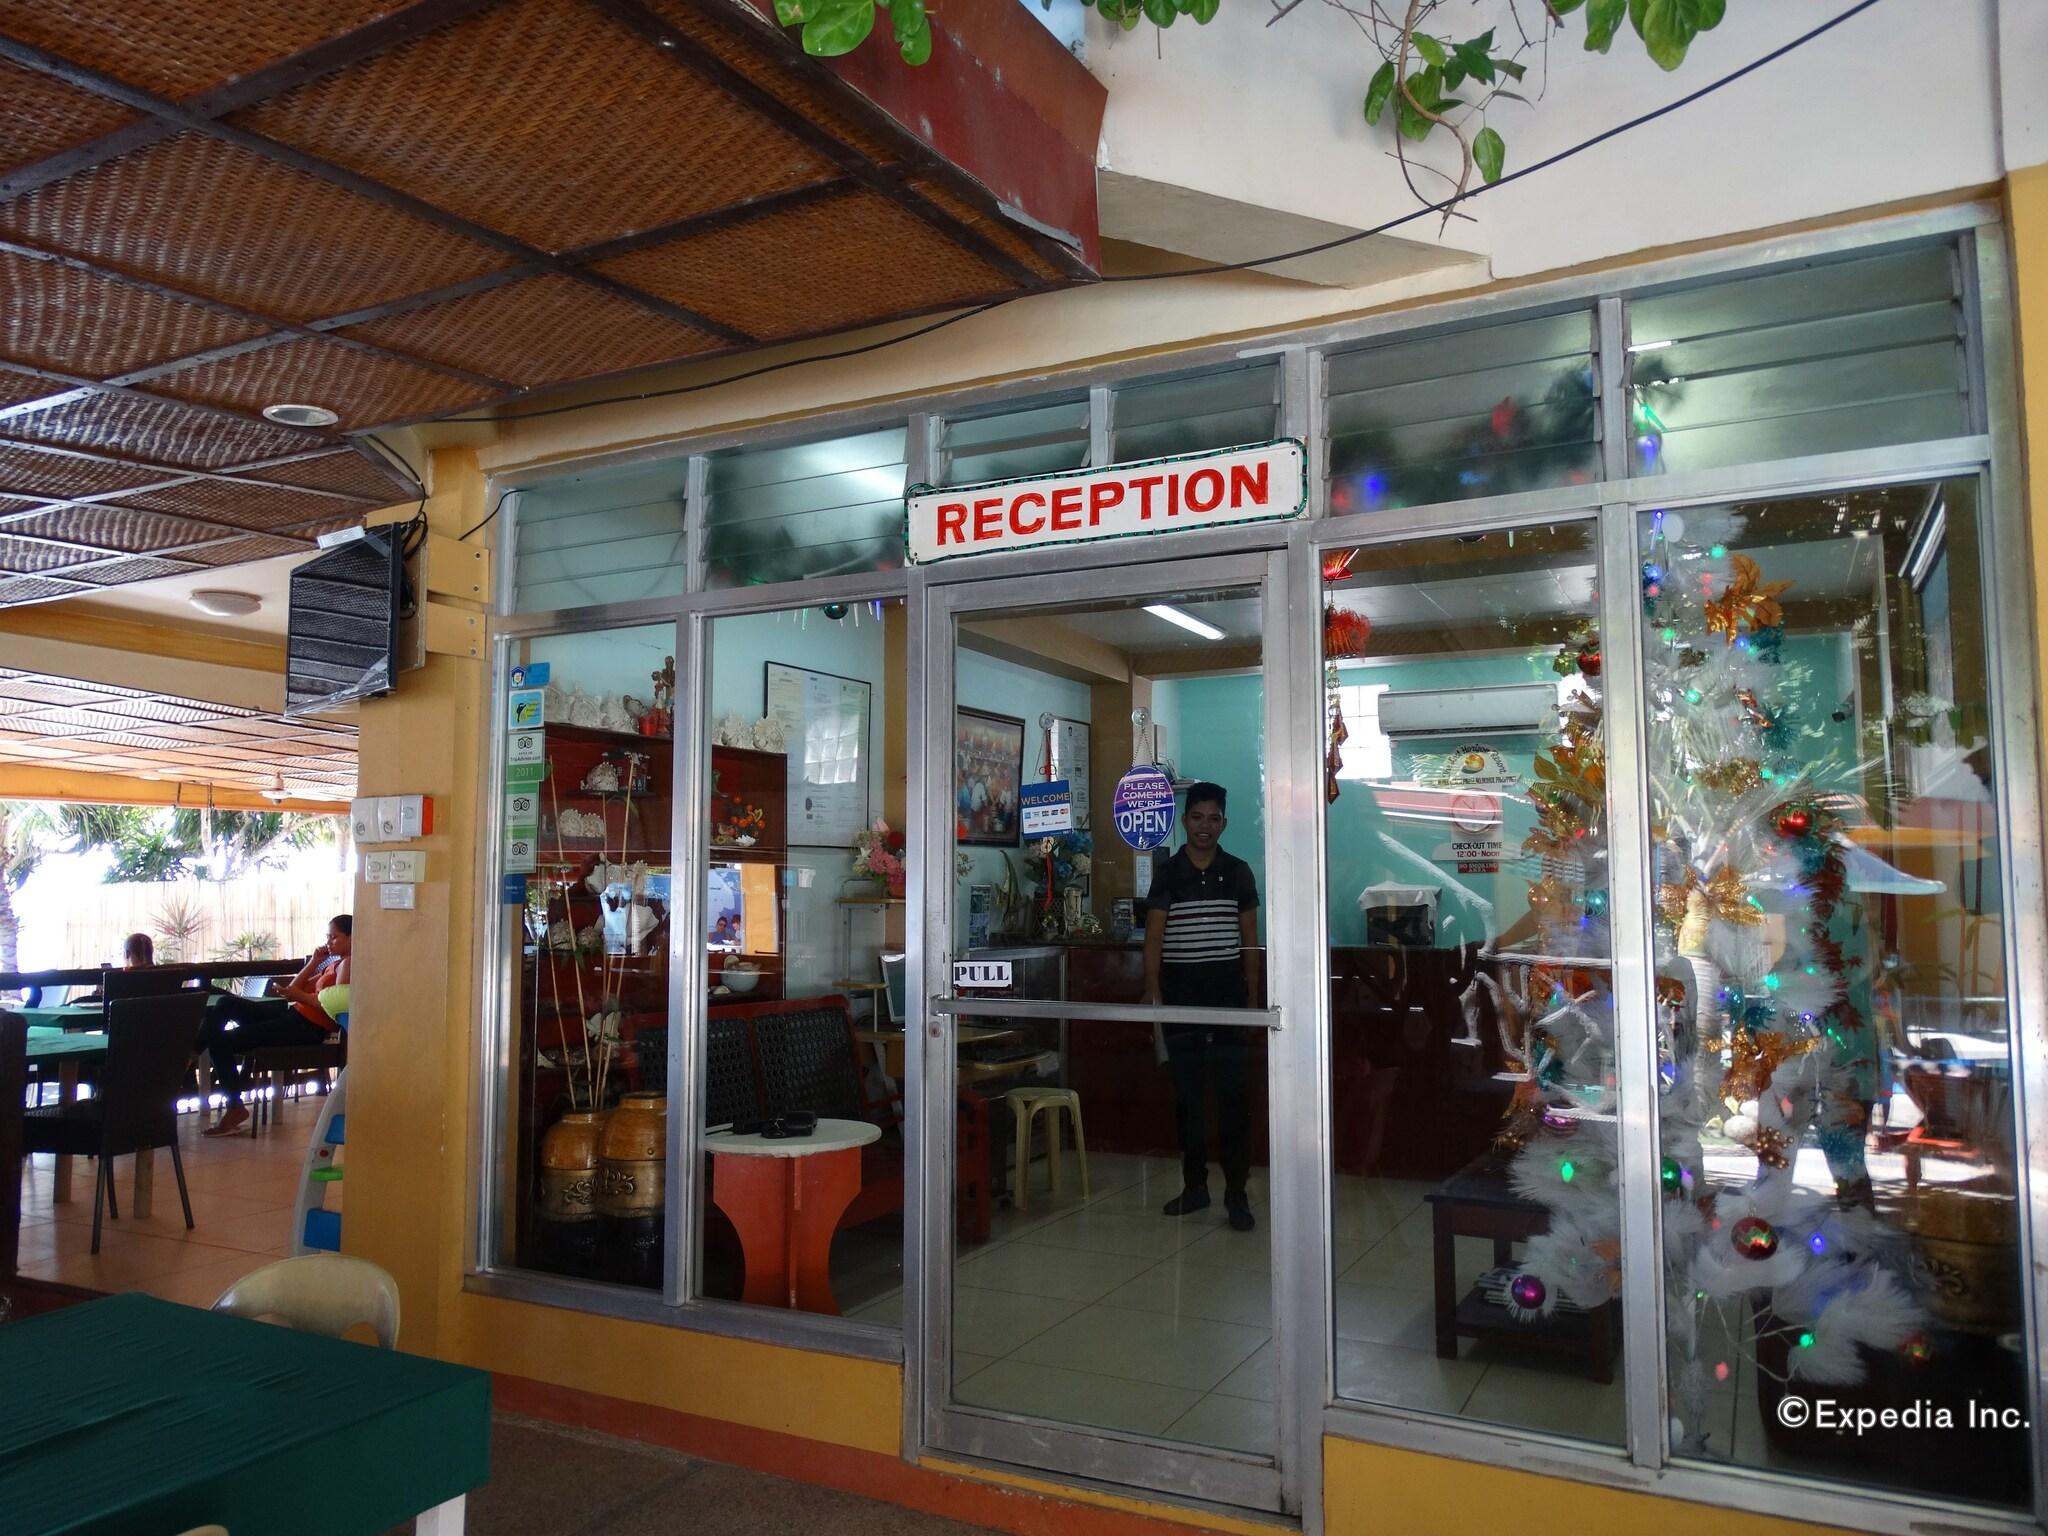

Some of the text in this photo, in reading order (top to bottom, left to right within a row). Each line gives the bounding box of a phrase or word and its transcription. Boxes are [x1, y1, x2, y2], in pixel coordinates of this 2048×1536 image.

[937, 461, 1269, 546] RECEPTION
[1124, 782, 1166, 791] PLEASE
[1021, 792, 1071, 805] WELCOME
[1122, 791, 1167, 799] COME IN
[1127, 800, 1162, 808] WE'RE
[1120, 811, 1167, 833] OPEN
[1452, 841, 1503, 850] CHECK-OUT TIME
[954, 965, 1009, 982] PULL
